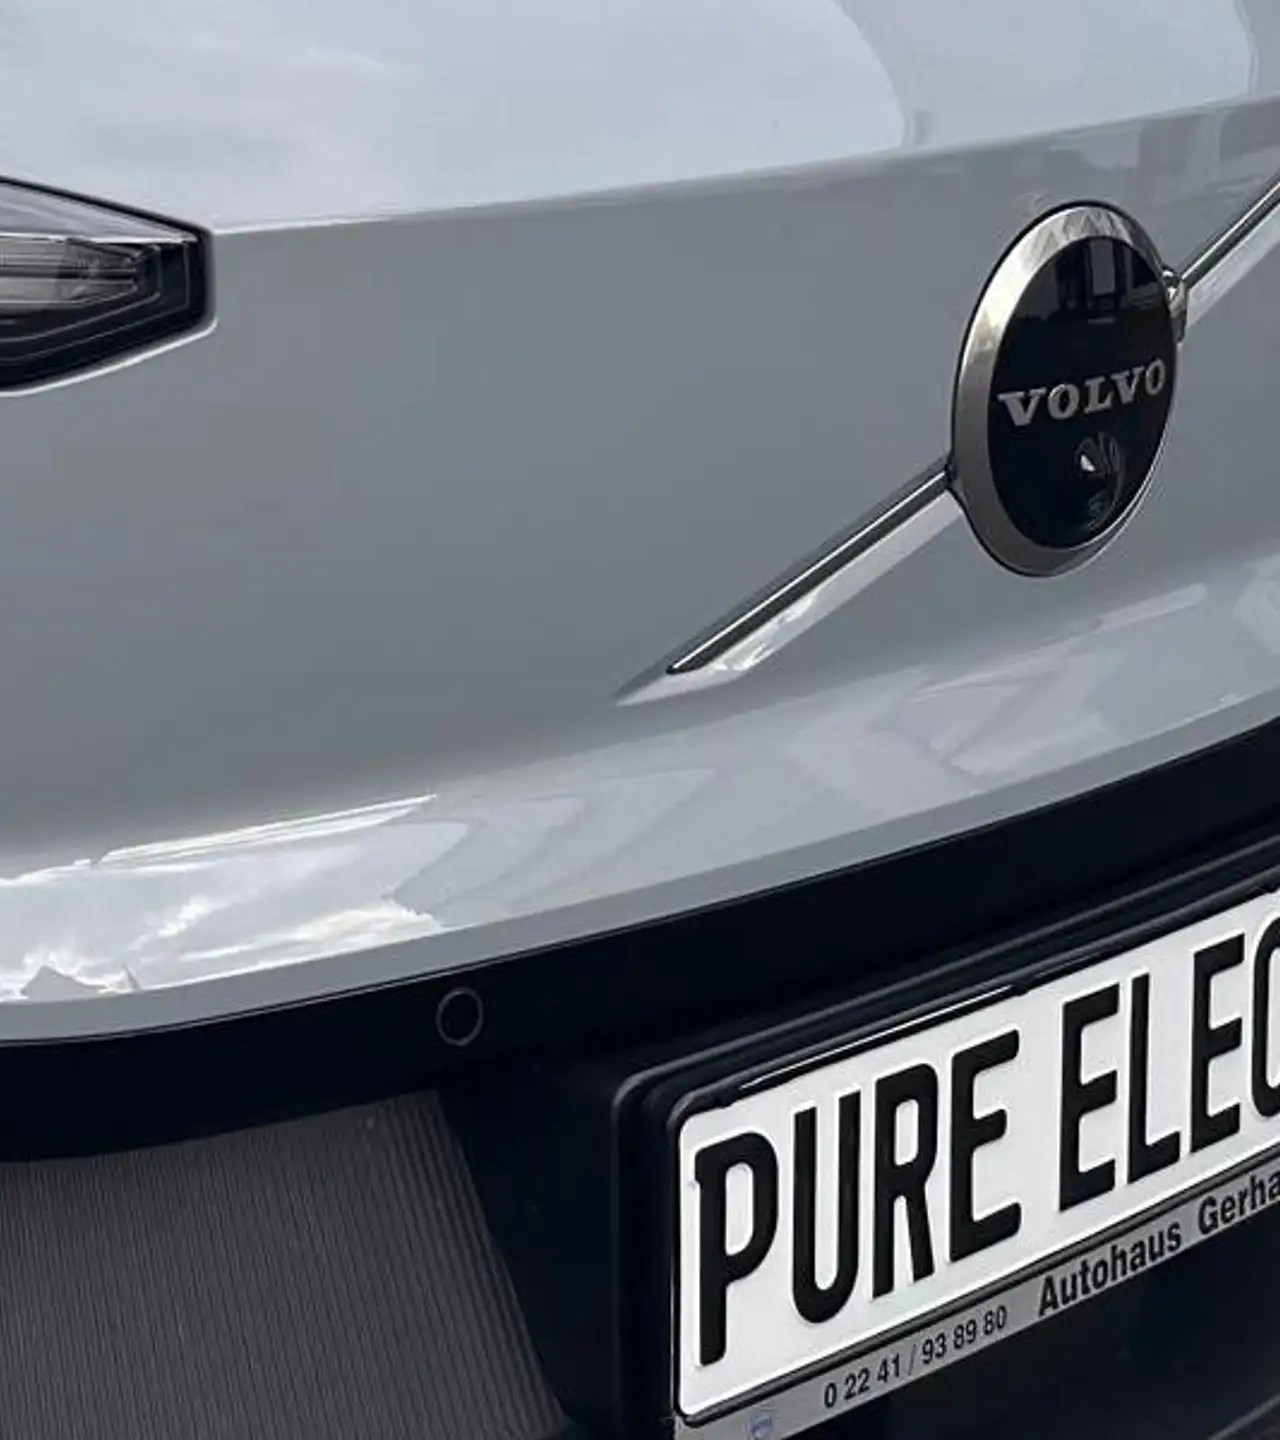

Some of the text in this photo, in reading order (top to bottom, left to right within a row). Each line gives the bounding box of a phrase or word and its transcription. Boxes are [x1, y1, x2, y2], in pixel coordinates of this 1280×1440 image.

[997, 358, 1166, 427] VOLVO
[694, 1028, 1021, 1366] PURE
[823, 1382, 838, 1408] 0
[843, 1367, 871, 1401] 22
[876, 1353, 901, 1384] 41
[921, 1332, 948, 1364] 93
[952, 1319, 978, 1350] 89
[983, 1305, 1008, 1336] 80
[1038, 1221, 1182, 1317] Autohaus
